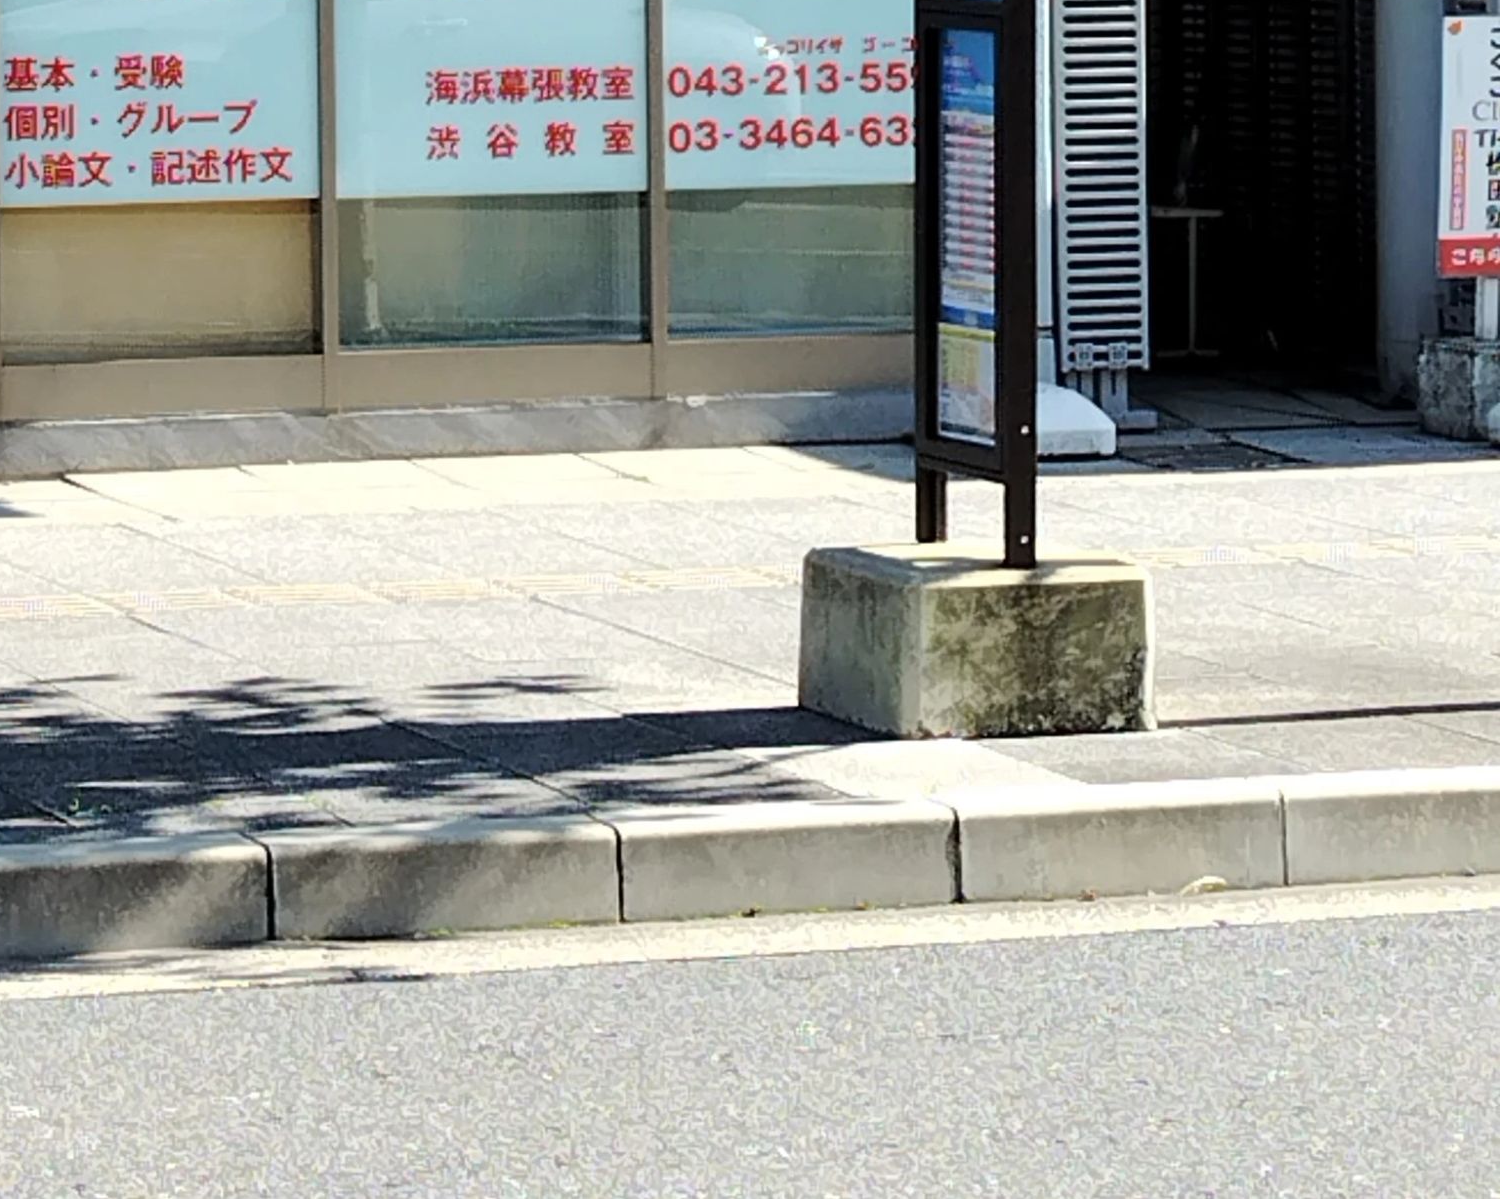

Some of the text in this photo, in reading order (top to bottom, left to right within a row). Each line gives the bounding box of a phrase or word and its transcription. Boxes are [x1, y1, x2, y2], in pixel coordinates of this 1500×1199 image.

[425, 65, 635, 104] 海浜幕張教室
[426, 119, 636, 160] 渋谷教室
